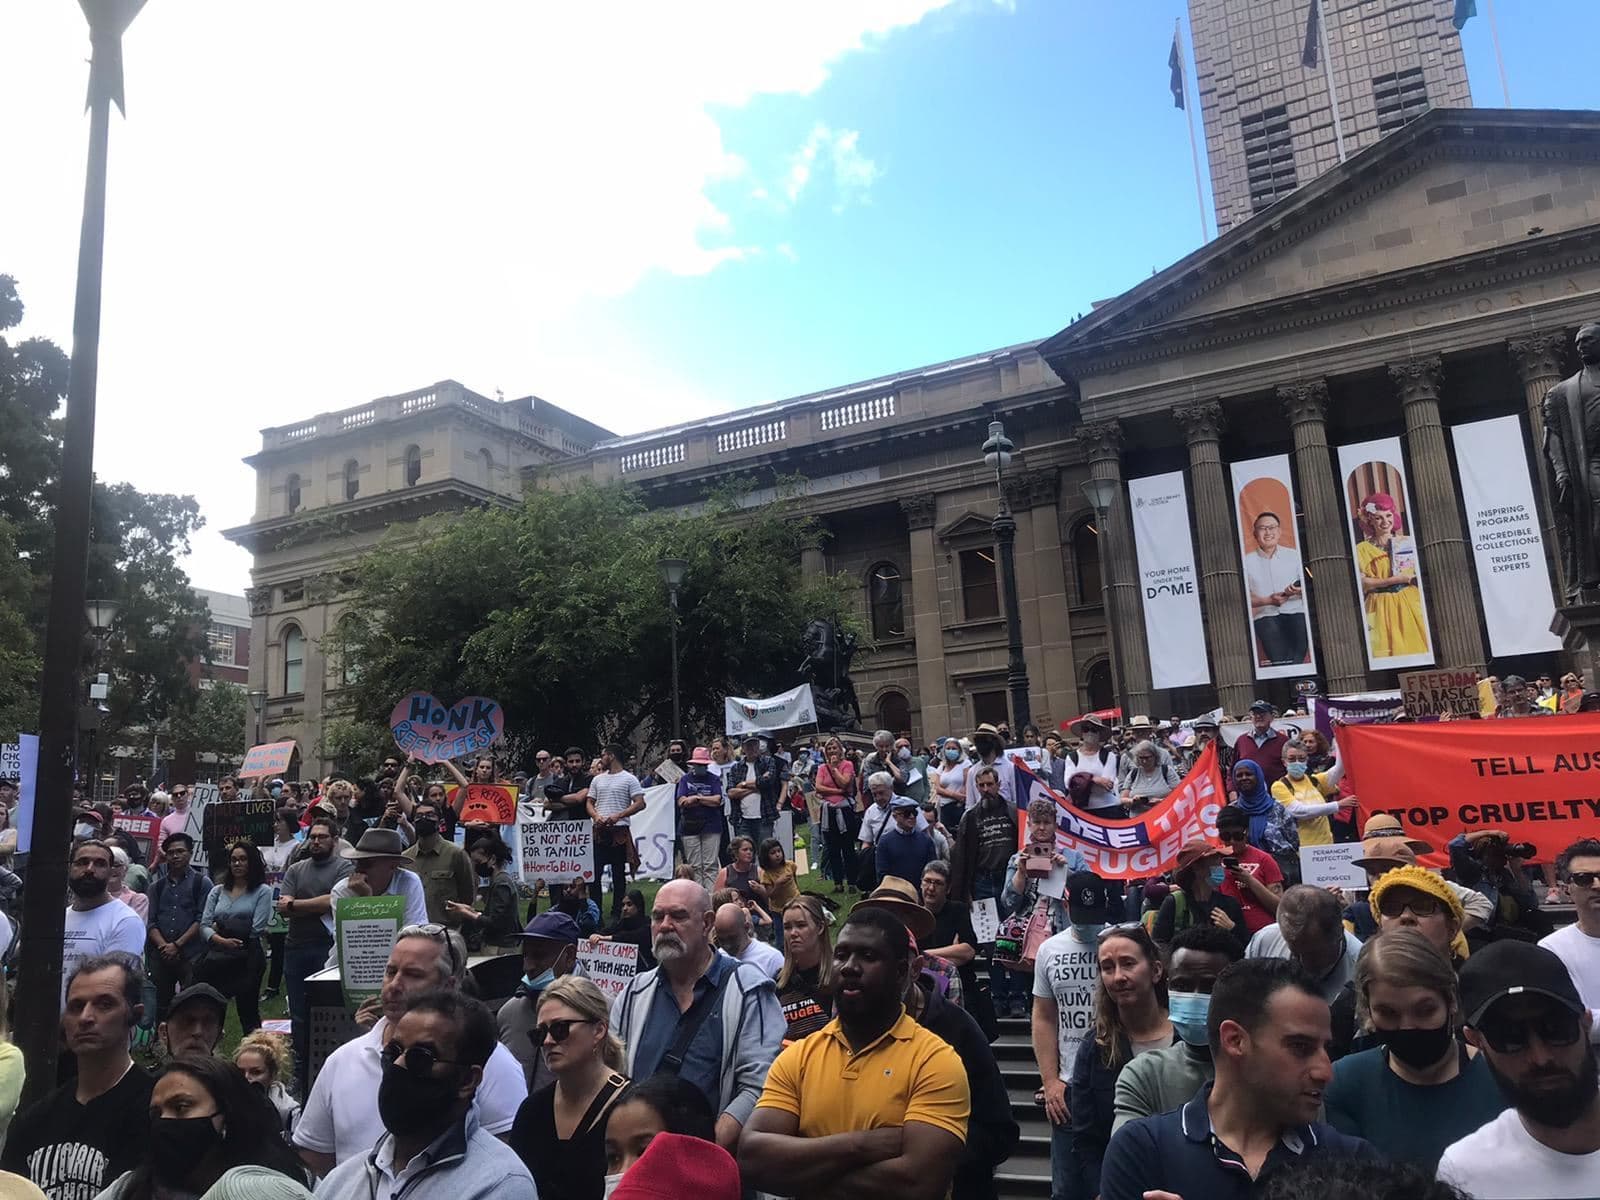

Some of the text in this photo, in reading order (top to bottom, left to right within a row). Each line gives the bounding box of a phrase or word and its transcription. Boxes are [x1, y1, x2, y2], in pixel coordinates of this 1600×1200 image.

[1477, 504, 1525, 518] INSPIRING
[1475, 513, 1530, 528] PROGRAMS
[1479, 527, 1533, 542] INCREDIBLE
[1475, 535, 1541, 551] COLLECTIONS
[1491, 552, 1529, 564] TRUSTED
[1144, 565, 1191, 578] YOUR HOME
[1492, 561, 1531, 573] EXPERTS
[1406, 671, 1477, 691] FREEDOM
[1430, 685, 1473, 702] BASIC
[1403, 697, 1480, 719] HUMAN RIGHT
[392, 719, 492, 760] REFUGEES
[1471, 756, 1545, 777] TELL
[245, 801, 273, 815] LIVES
[480, 788, 513, 819] REFUGEES
[1153, 770, 1216, 833] THE
[1370, 797, 1600, 829] TOP CRUELTY
[113, 818, 151, 833] FREE
[522, 821, 585, 834] DEPORTATION
[526, 833, 591, 845] IS NOT SAFE
[523, 845, 587, 858] FOR TAMILS
[523, 859, 582, 873] #HomeToBilo
[599, 942, 611, 955] THE
[612, 944, 637, 960] CAMPS
[594, 959, 614, 974] THEM
[613, 961, 636, 977] HERE
[1056, 992, 1096, 1007] HUM
